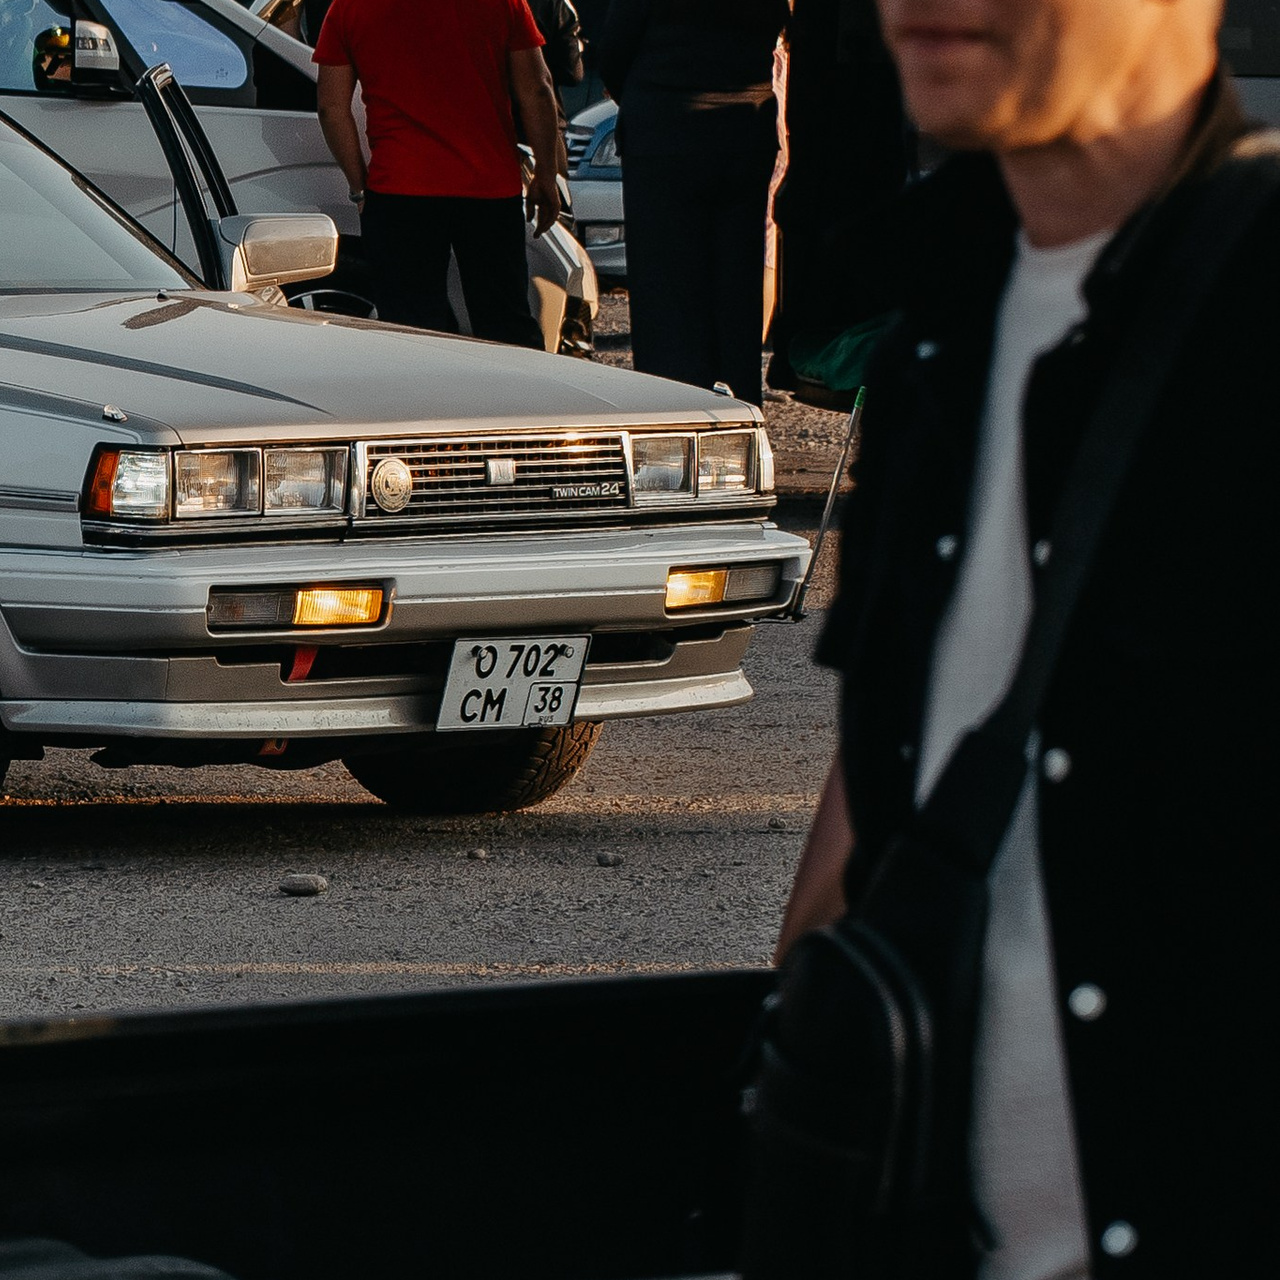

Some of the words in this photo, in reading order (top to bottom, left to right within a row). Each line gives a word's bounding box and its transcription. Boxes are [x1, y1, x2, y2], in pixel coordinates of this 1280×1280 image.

[601, 483, 620, 495] 24
[506, 644, 560, 678] 702
[534, 686, 564, 713] 38
